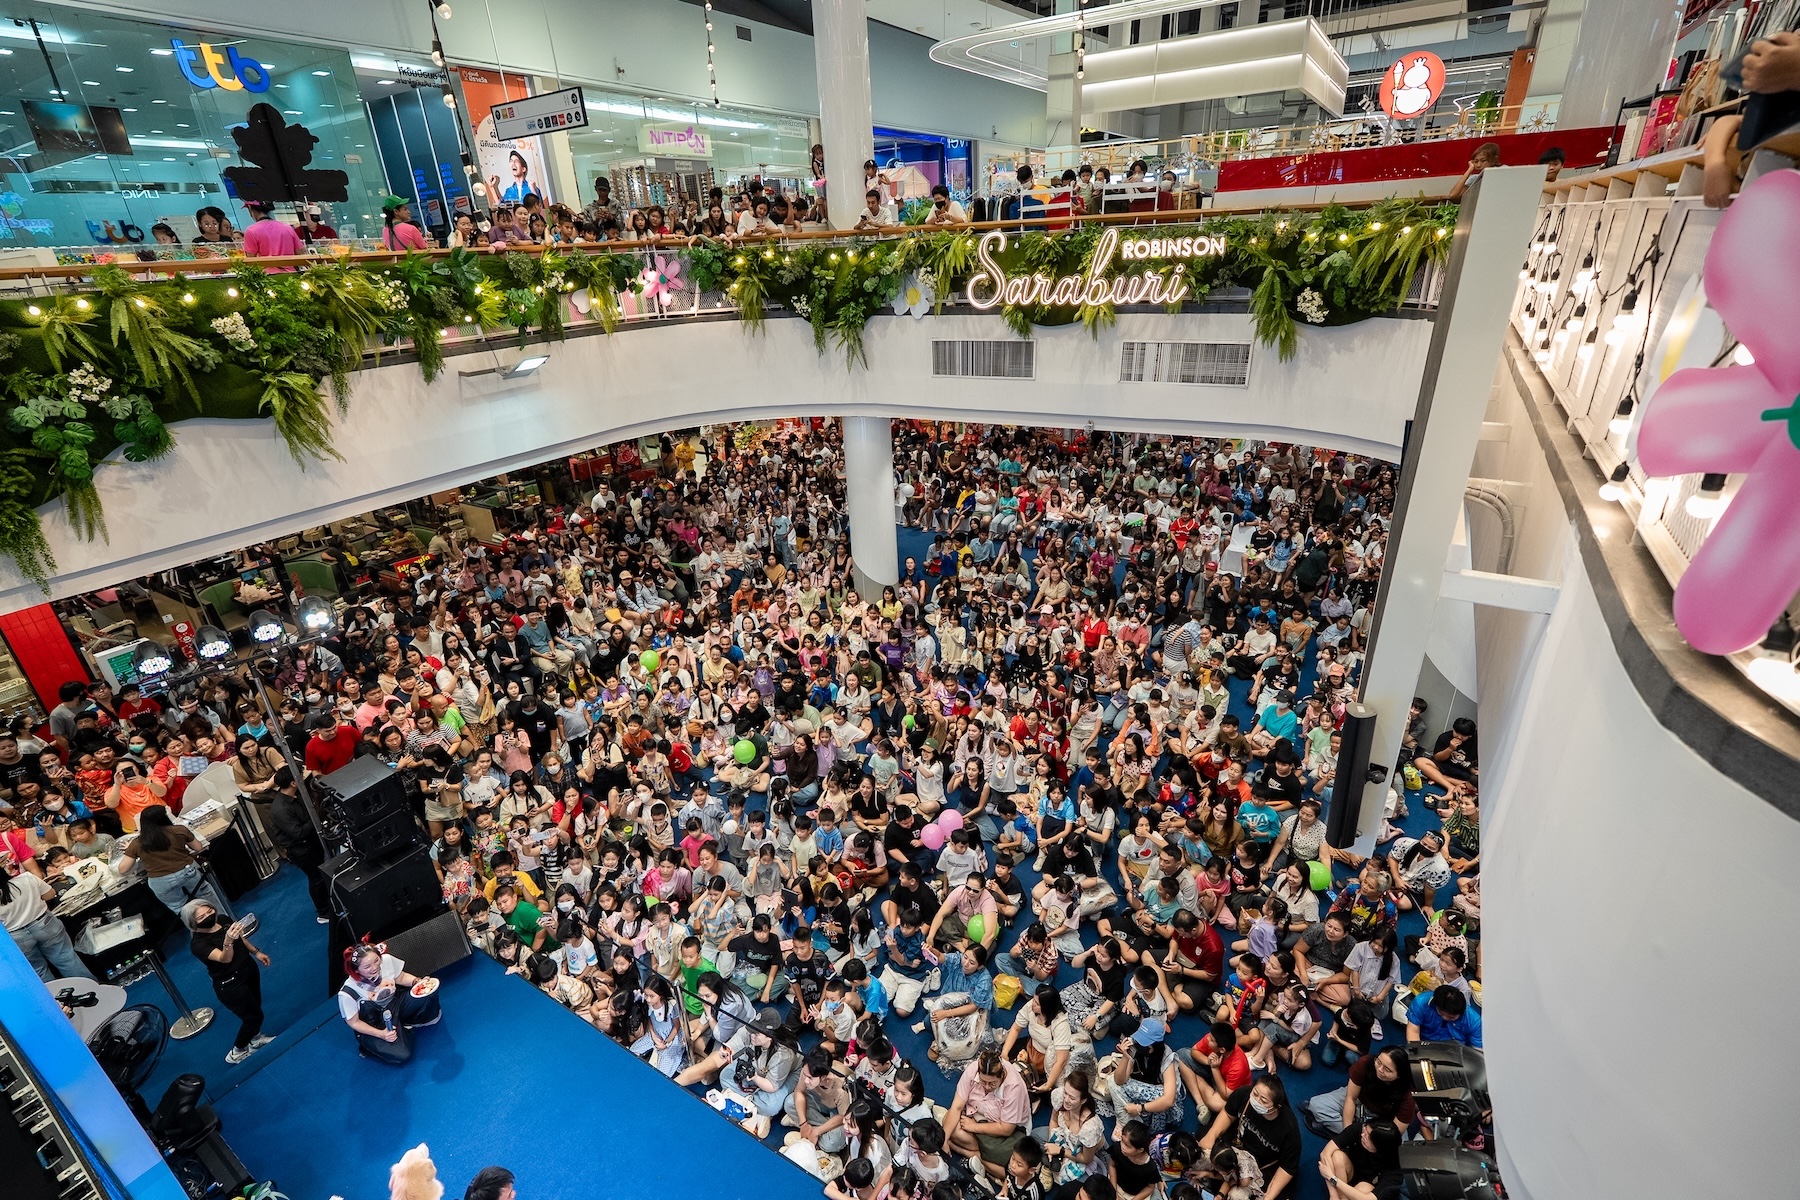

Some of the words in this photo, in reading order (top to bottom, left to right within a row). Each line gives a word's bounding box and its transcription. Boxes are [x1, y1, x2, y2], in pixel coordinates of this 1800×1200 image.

[170, 38, 270, 94] ttb
[650, 127, 705, 149] NITIPON
[86, 219, 145, 243] ttb
[1121, 236, 1226, 259] ROBINSON
[967, 226, 1189, 310] Saraburi
